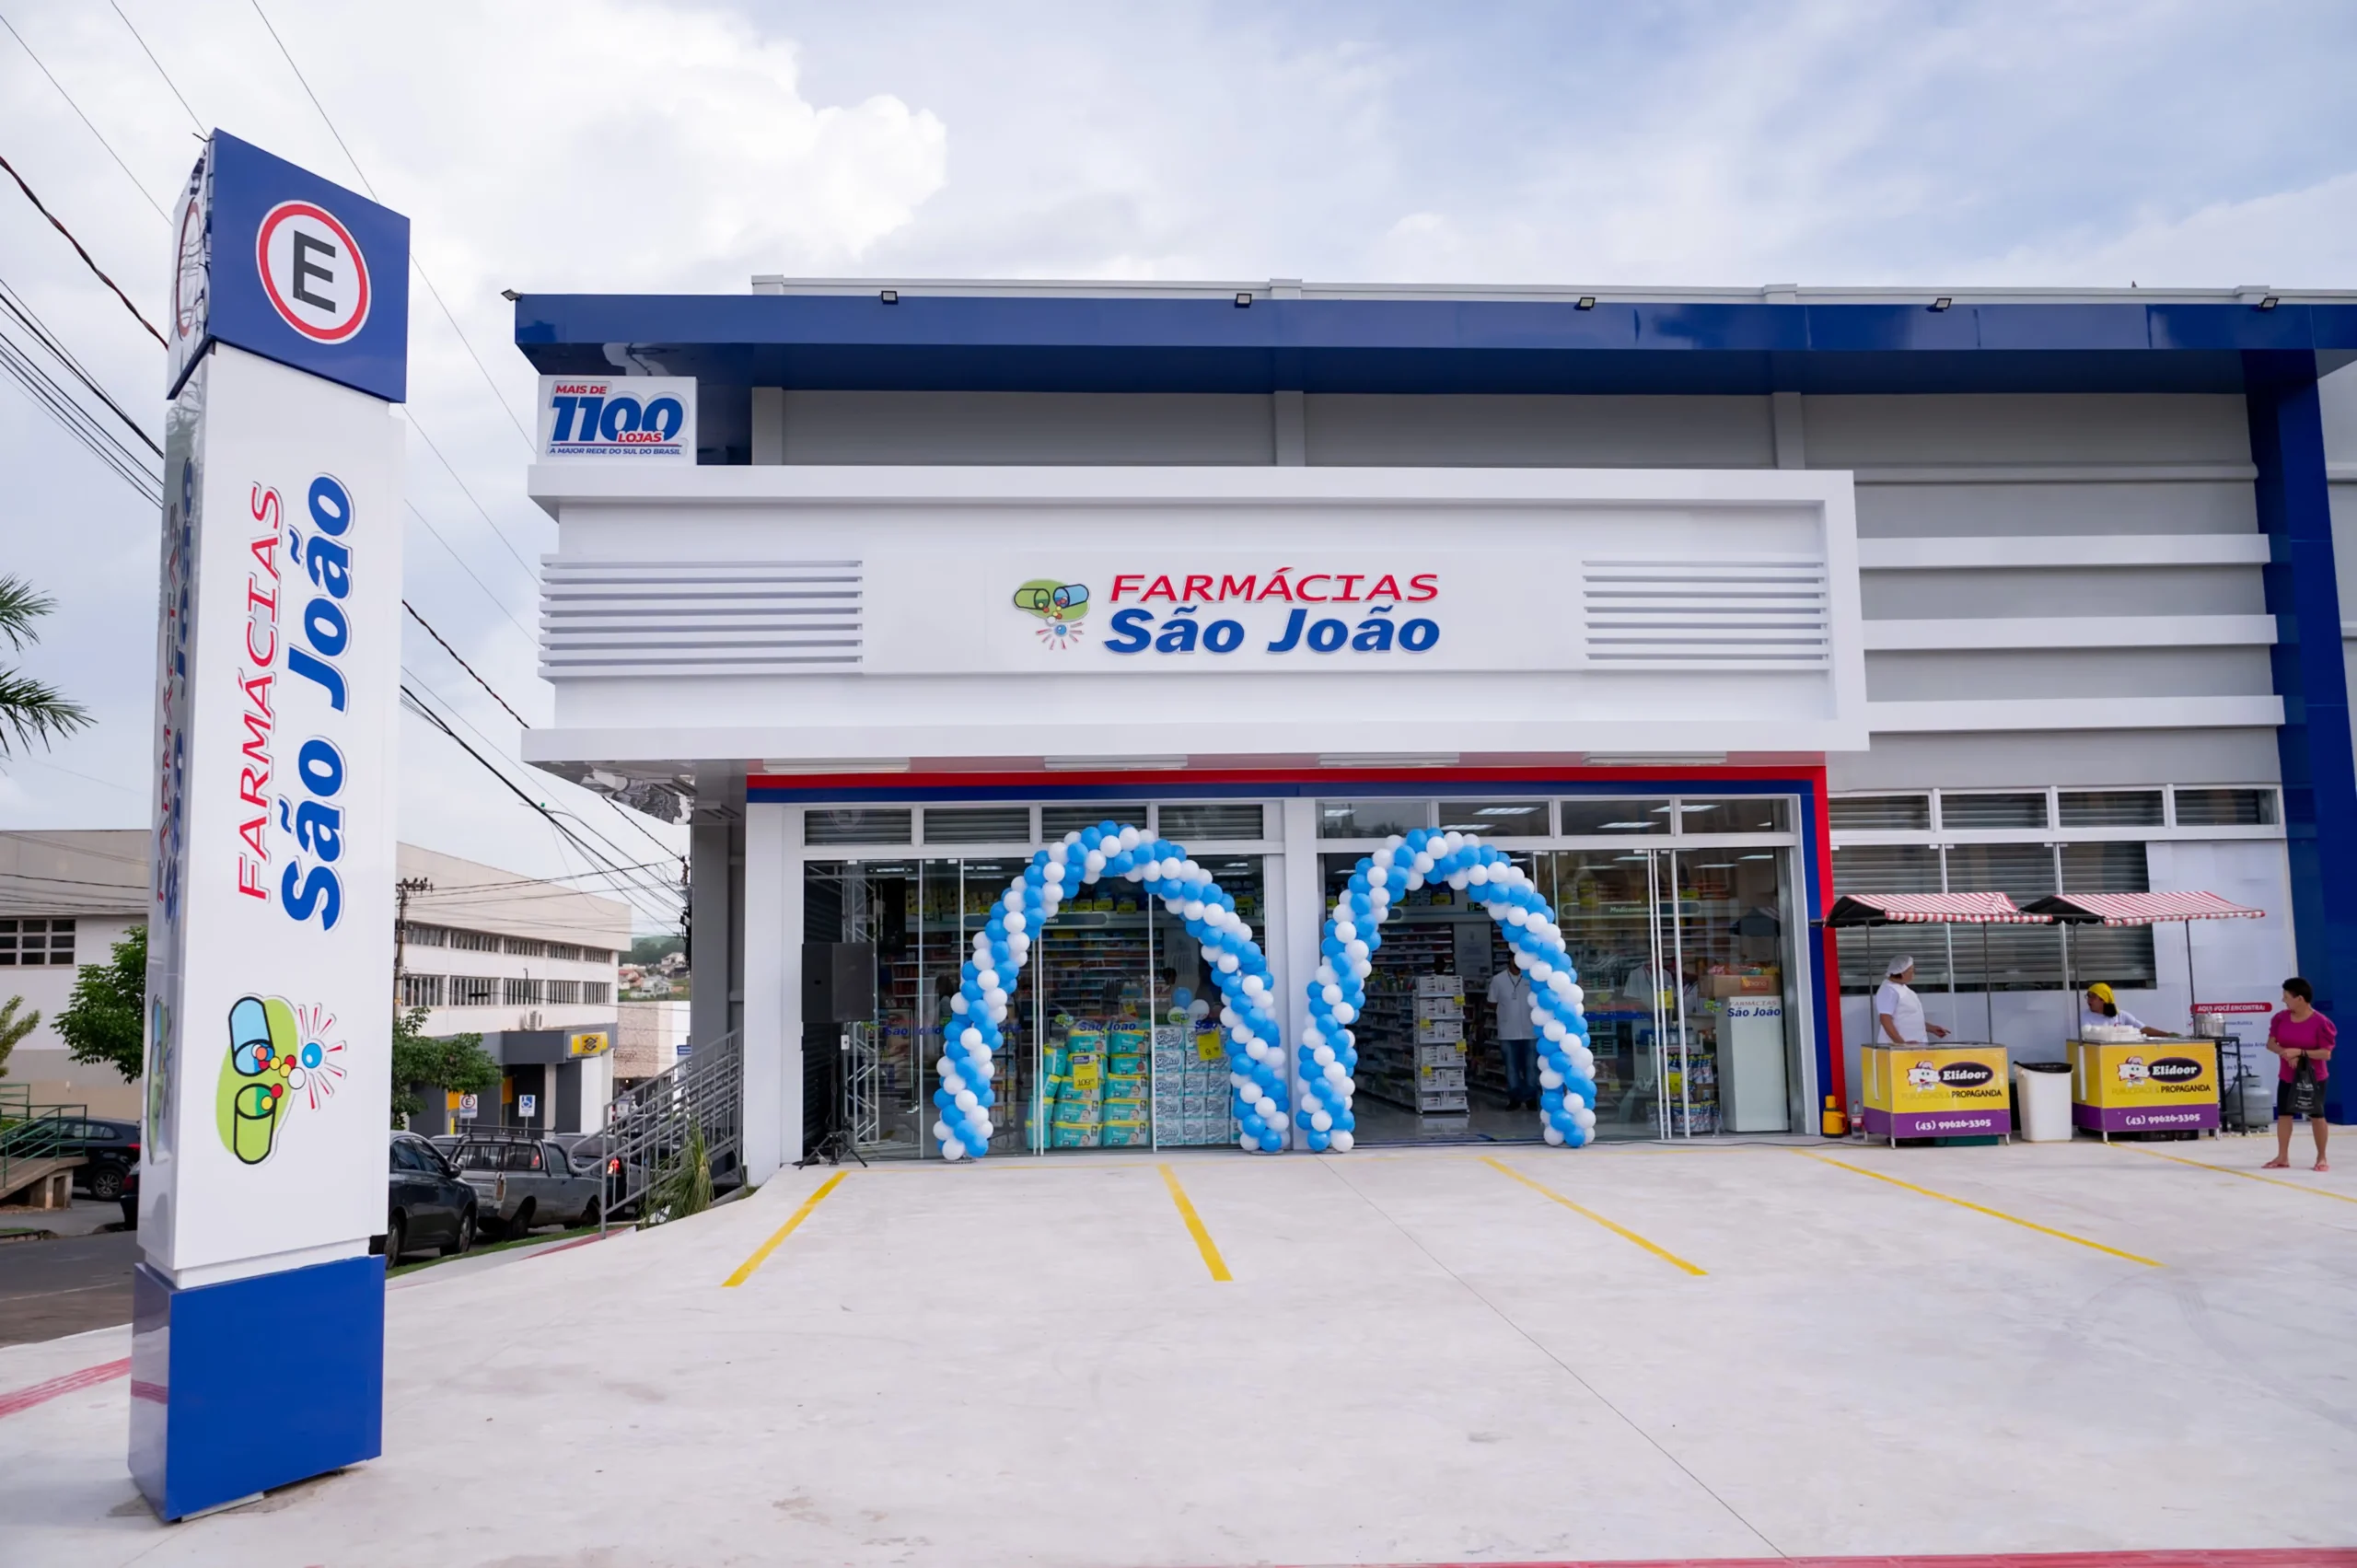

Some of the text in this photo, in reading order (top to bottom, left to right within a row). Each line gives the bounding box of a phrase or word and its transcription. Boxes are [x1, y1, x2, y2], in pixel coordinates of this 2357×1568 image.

[293, 229, 337, 314] E
[555, 386, 607, 394] MAIS DE
[552, 397, 683, 442] 1100
[618, 433, 662, 443] LOJAS
[1110, 566, 1439, 602] FARMÁCIAS
[1105, 606, 1440, 653] São João
[238, 484, 281, 900] FARMÁCIAS
[280, 471, 351, 931] São João
[1727, 1006, 1781, 1016] São João
[2152, 1065, 2198, 1075] Elidoor
[1942, 1070, 1989, 1081] Elidoor
[1951, 1089, 2003, 1098] PROPAGANDA
[2161, 1085, 2212, 1093] PROPAGANDA
[465, 1098, 471, 1106] E
[2126, 1115, 2146, 1125] (43)
[1915, 1120, 1936, 1131] (43)
